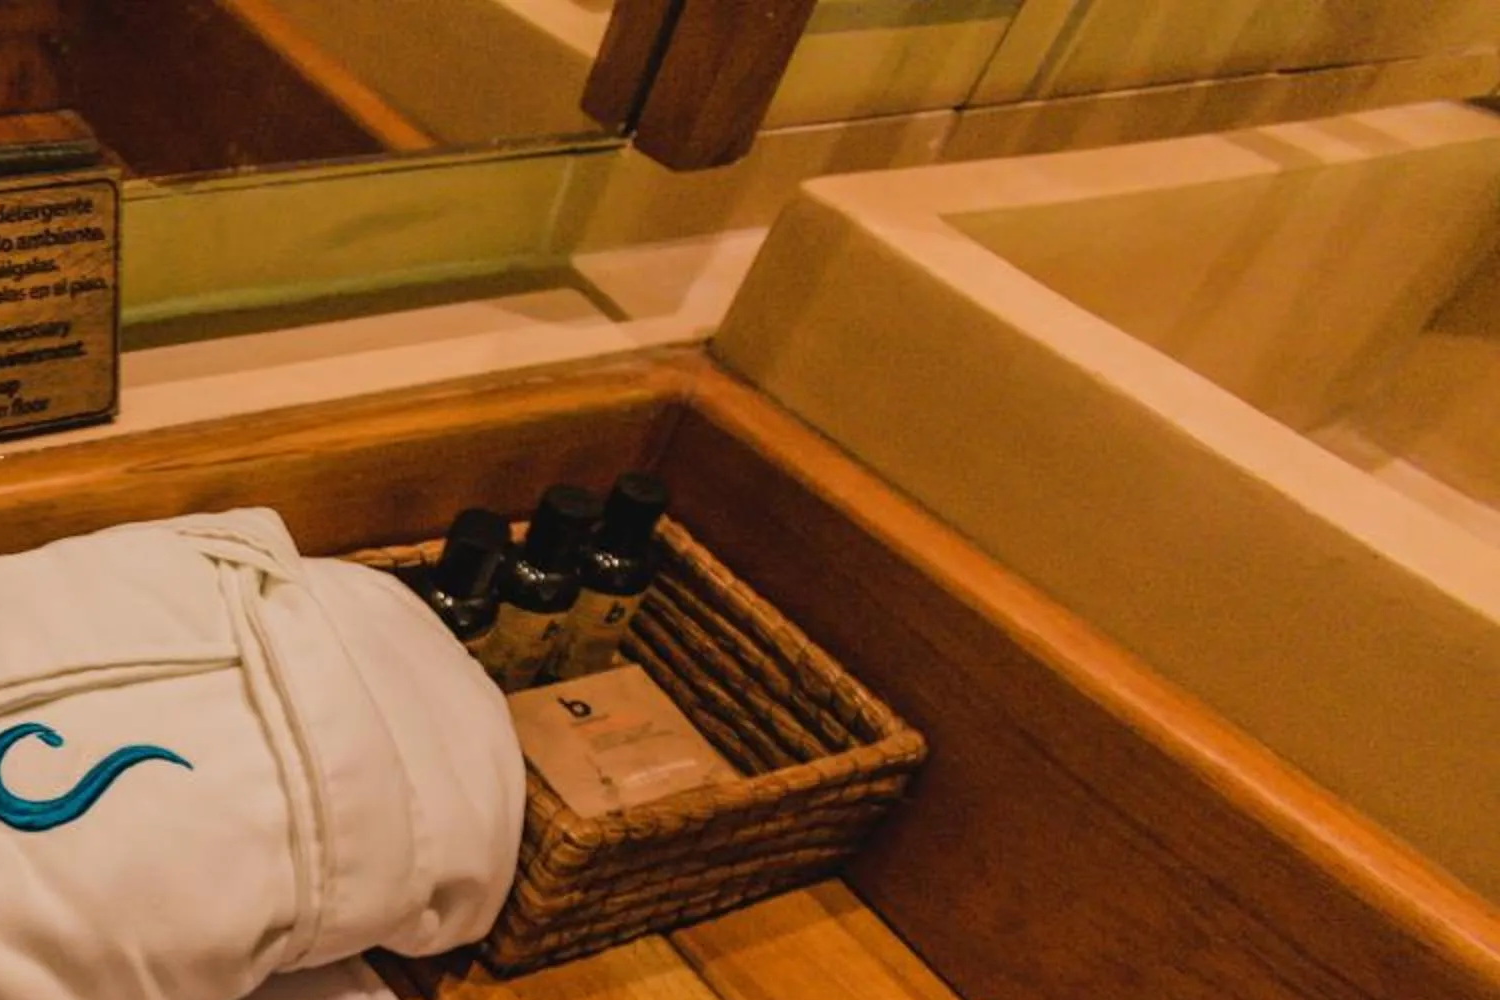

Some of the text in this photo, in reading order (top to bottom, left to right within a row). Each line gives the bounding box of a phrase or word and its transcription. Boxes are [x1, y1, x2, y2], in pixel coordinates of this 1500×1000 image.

[30, 284, 49, 299] en
[53, 278, 68, 296] el
[11, 396, 51, 415] floor
